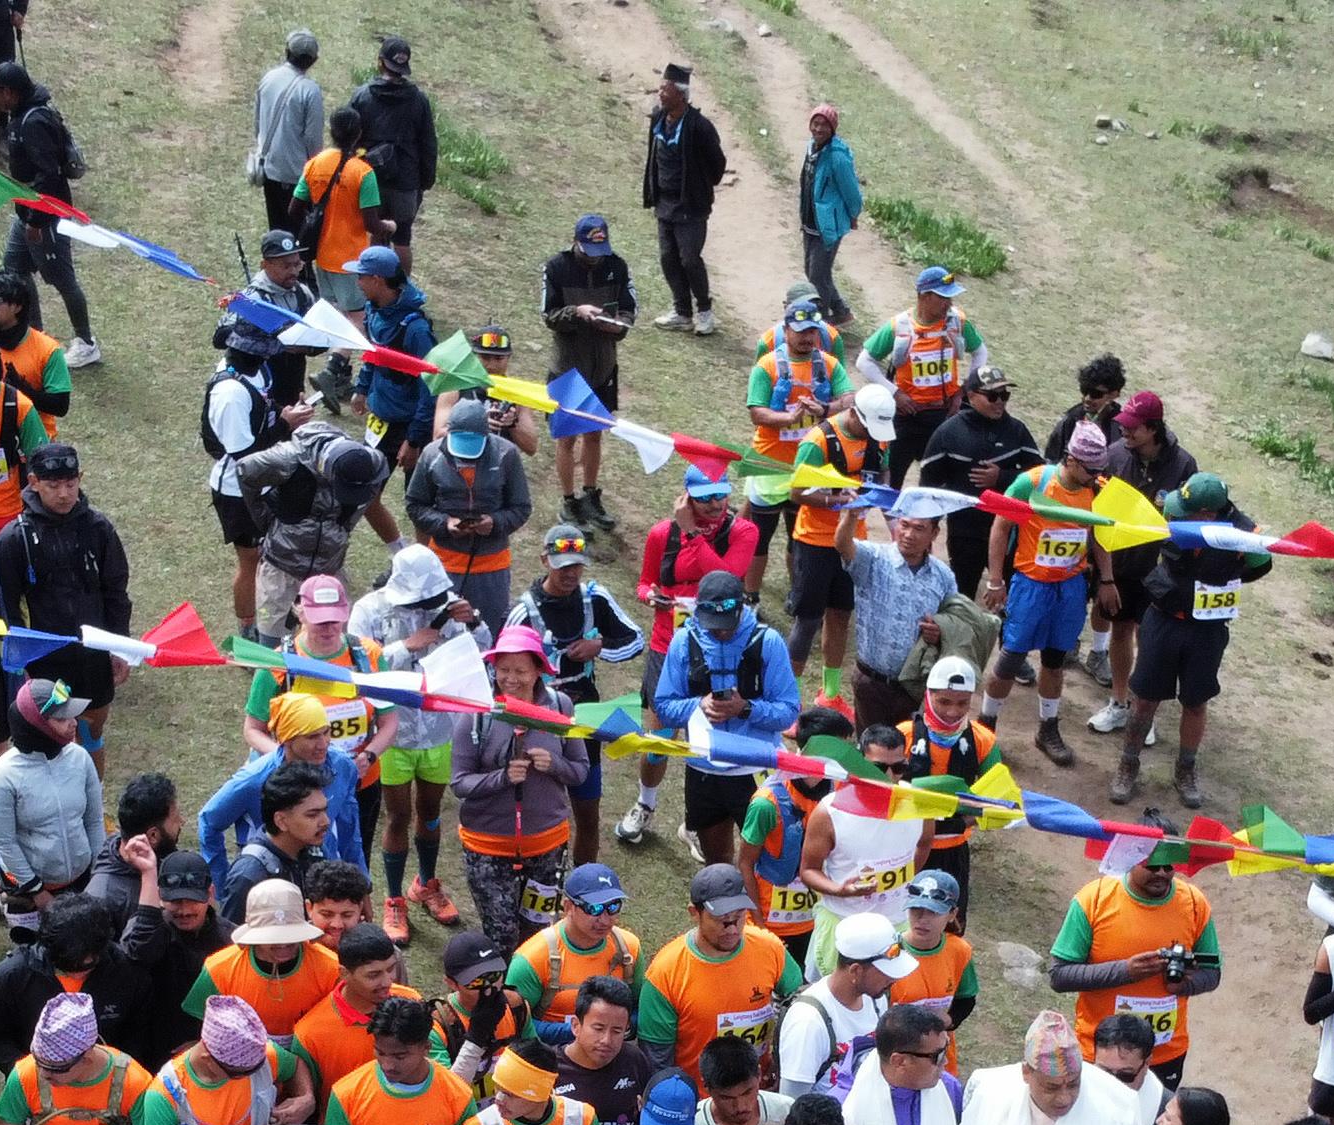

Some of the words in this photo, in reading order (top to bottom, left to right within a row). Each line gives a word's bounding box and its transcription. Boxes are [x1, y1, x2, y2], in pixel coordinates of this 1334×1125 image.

[914, 360, 949, 377] 106
[1042, 541, 1081, 557] 167
[1200, 592, 1236, 609] 158
[329, 717, 361, 739] 85
